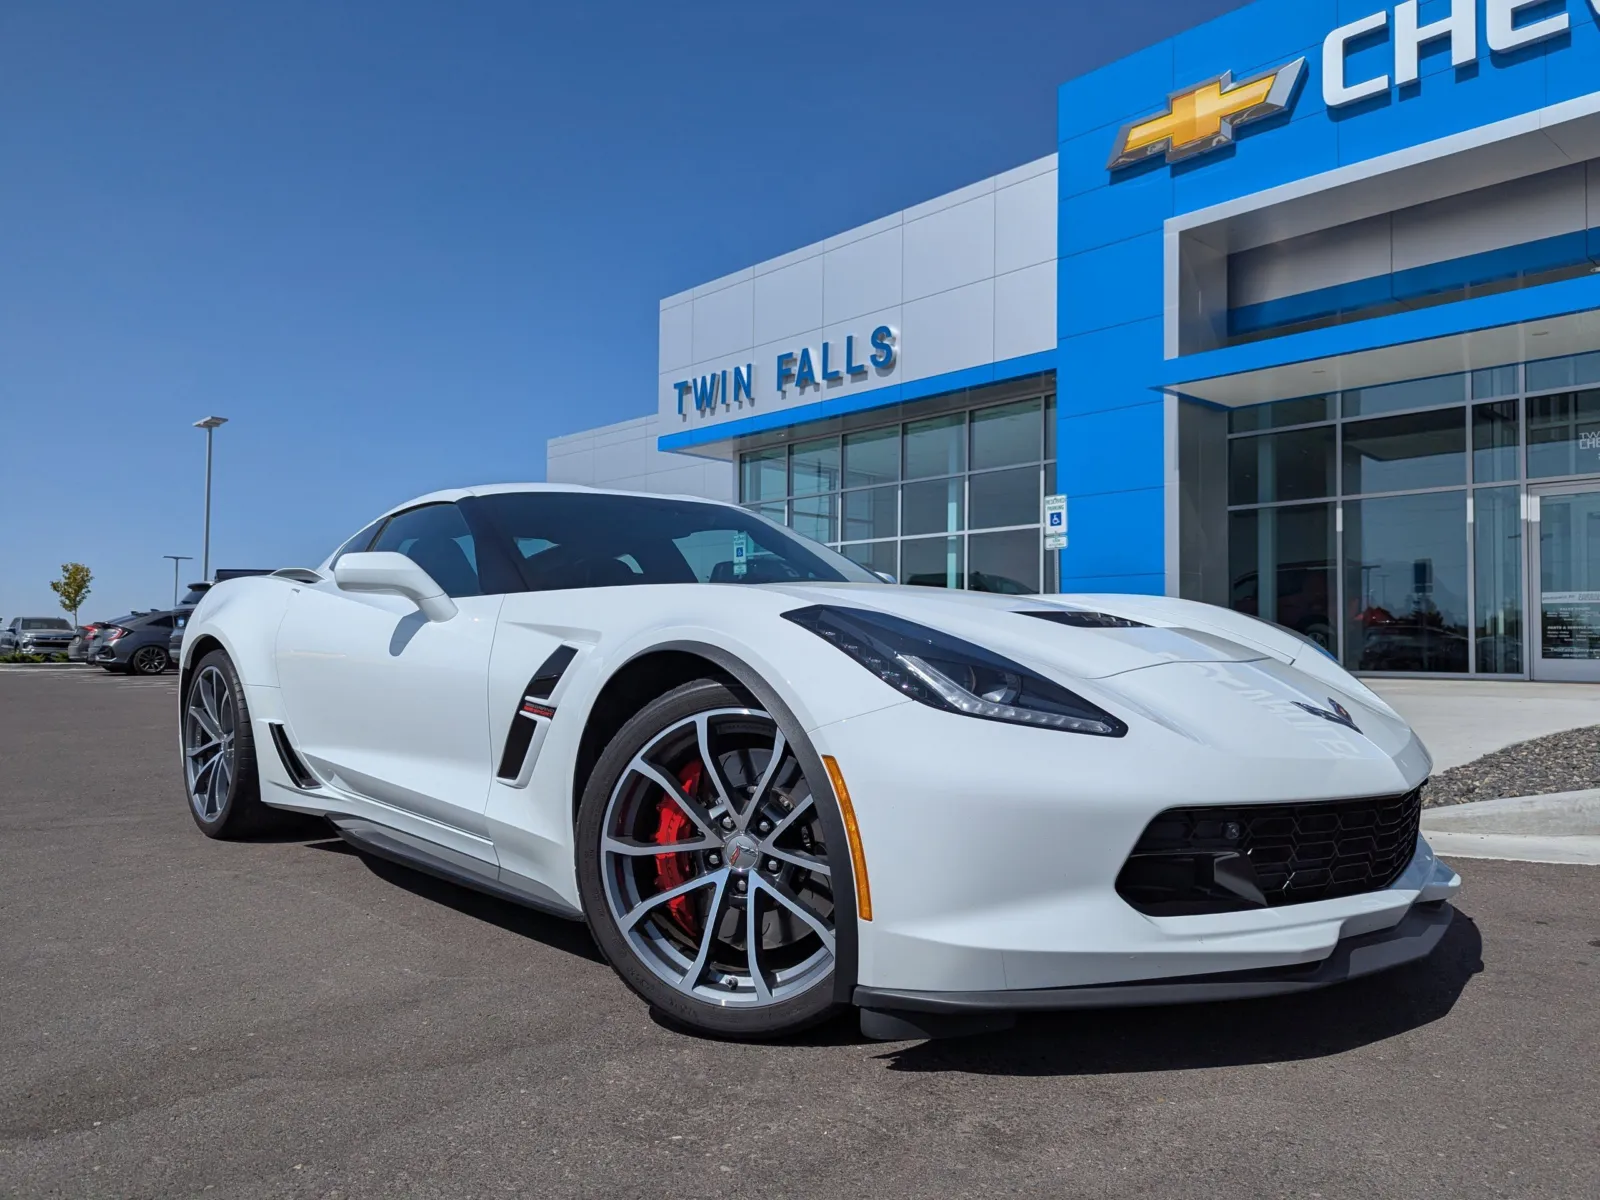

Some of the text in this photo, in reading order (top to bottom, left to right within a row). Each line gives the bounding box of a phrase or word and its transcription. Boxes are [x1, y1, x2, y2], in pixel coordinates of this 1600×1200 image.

[1322, 0, 1600, 107] CHE
[673, 325, 898, 416] TWIN FALLS
